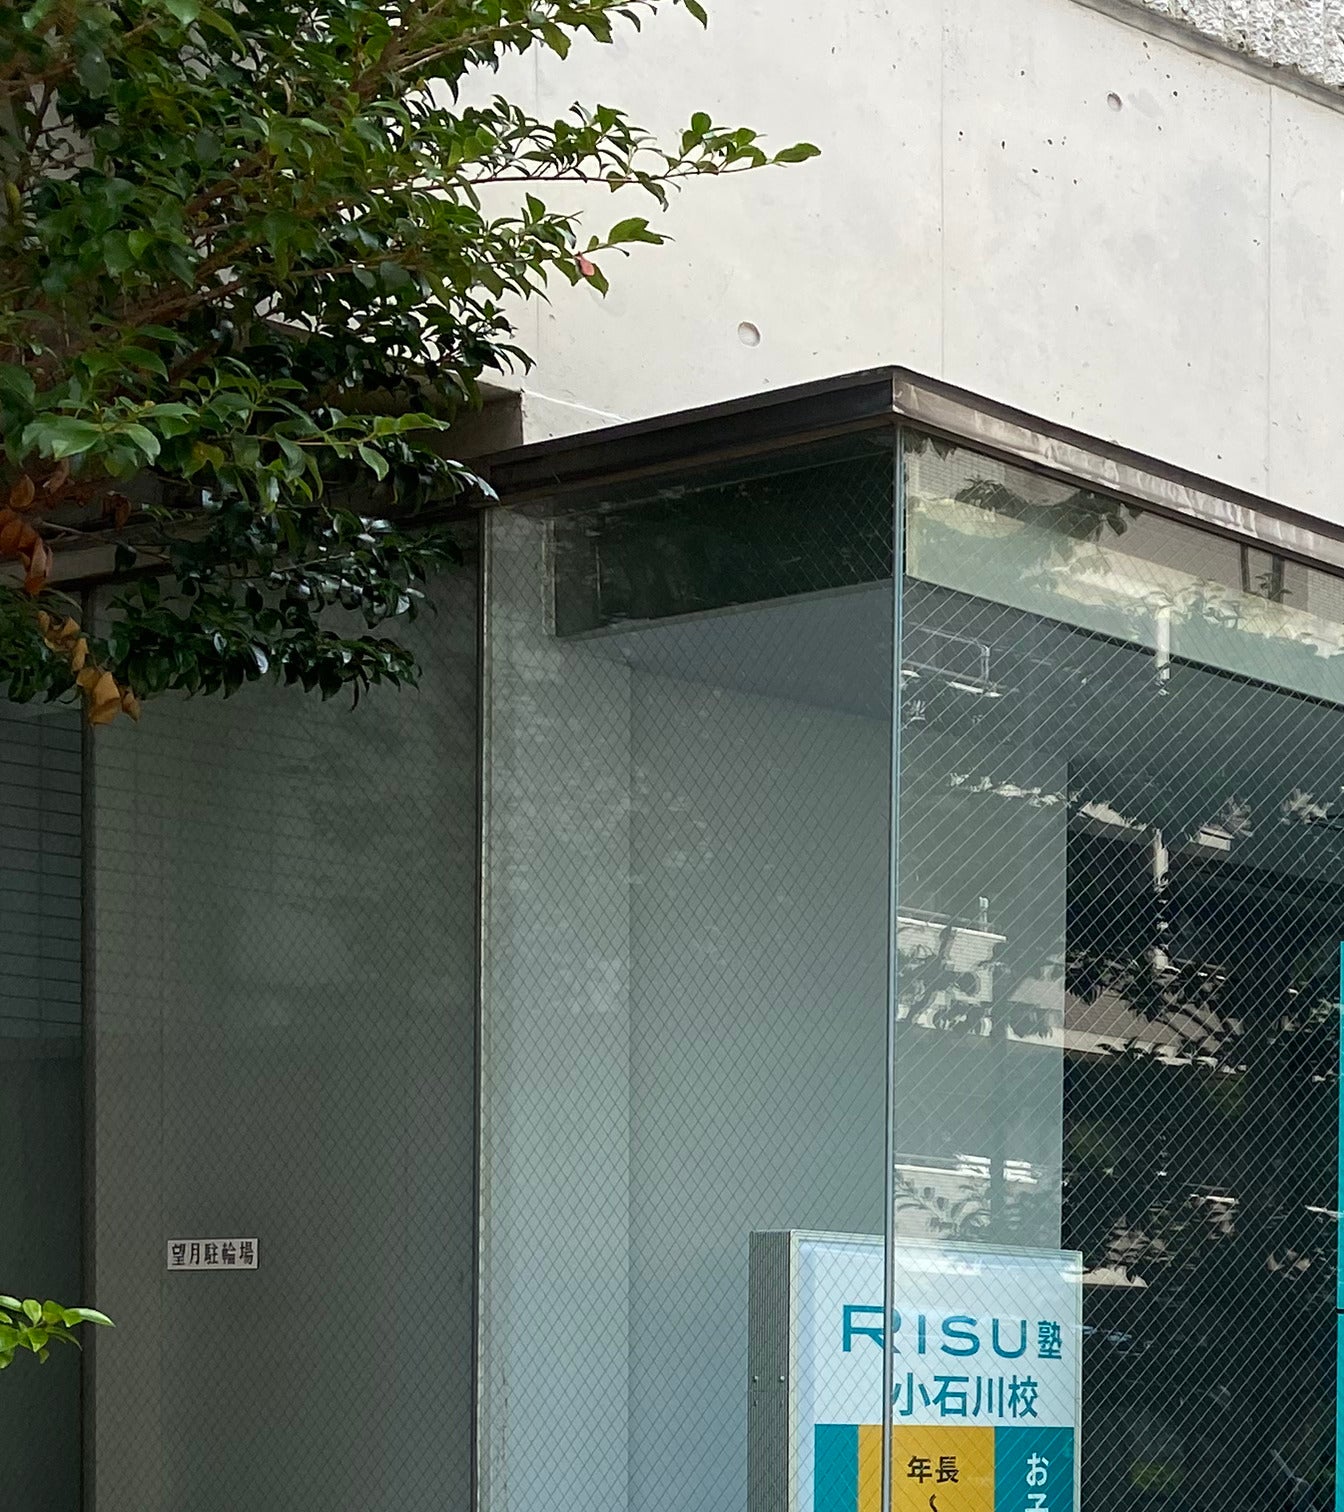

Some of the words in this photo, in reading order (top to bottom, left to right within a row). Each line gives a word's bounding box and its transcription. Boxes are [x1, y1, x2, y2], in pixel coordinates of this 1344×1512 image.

[171, 1241, 254, 1266] 望月駐輪場
[842, 1304, 1063, 1360] RISU塾
[892, 1371, 1039, 1419] 小石川校
[906, 1456, 960, 1484] 年長
